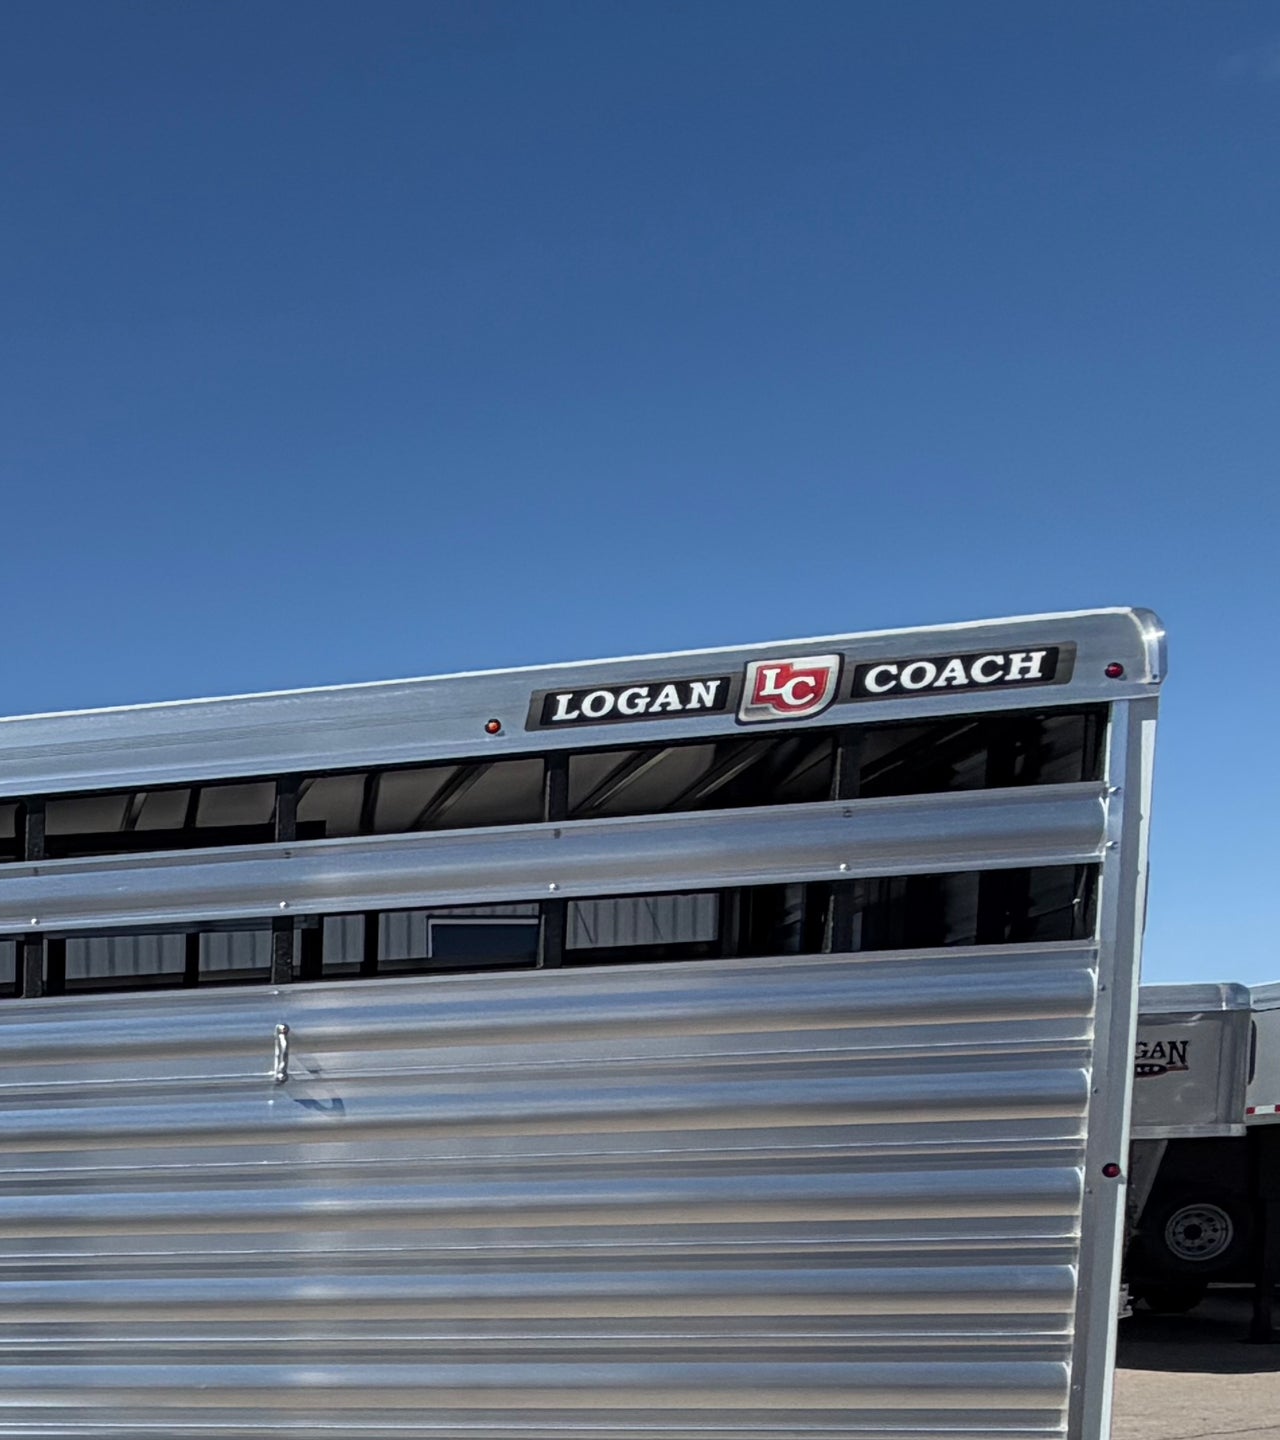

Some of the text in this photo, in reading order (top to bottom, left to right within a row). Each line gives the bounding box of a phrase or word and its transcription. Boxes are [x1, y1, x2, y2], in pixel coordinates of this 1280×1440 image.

[551, 651, 1046, 723] LOGAN LC COACH
[1135, 1040, 1189, 1066] GAN
